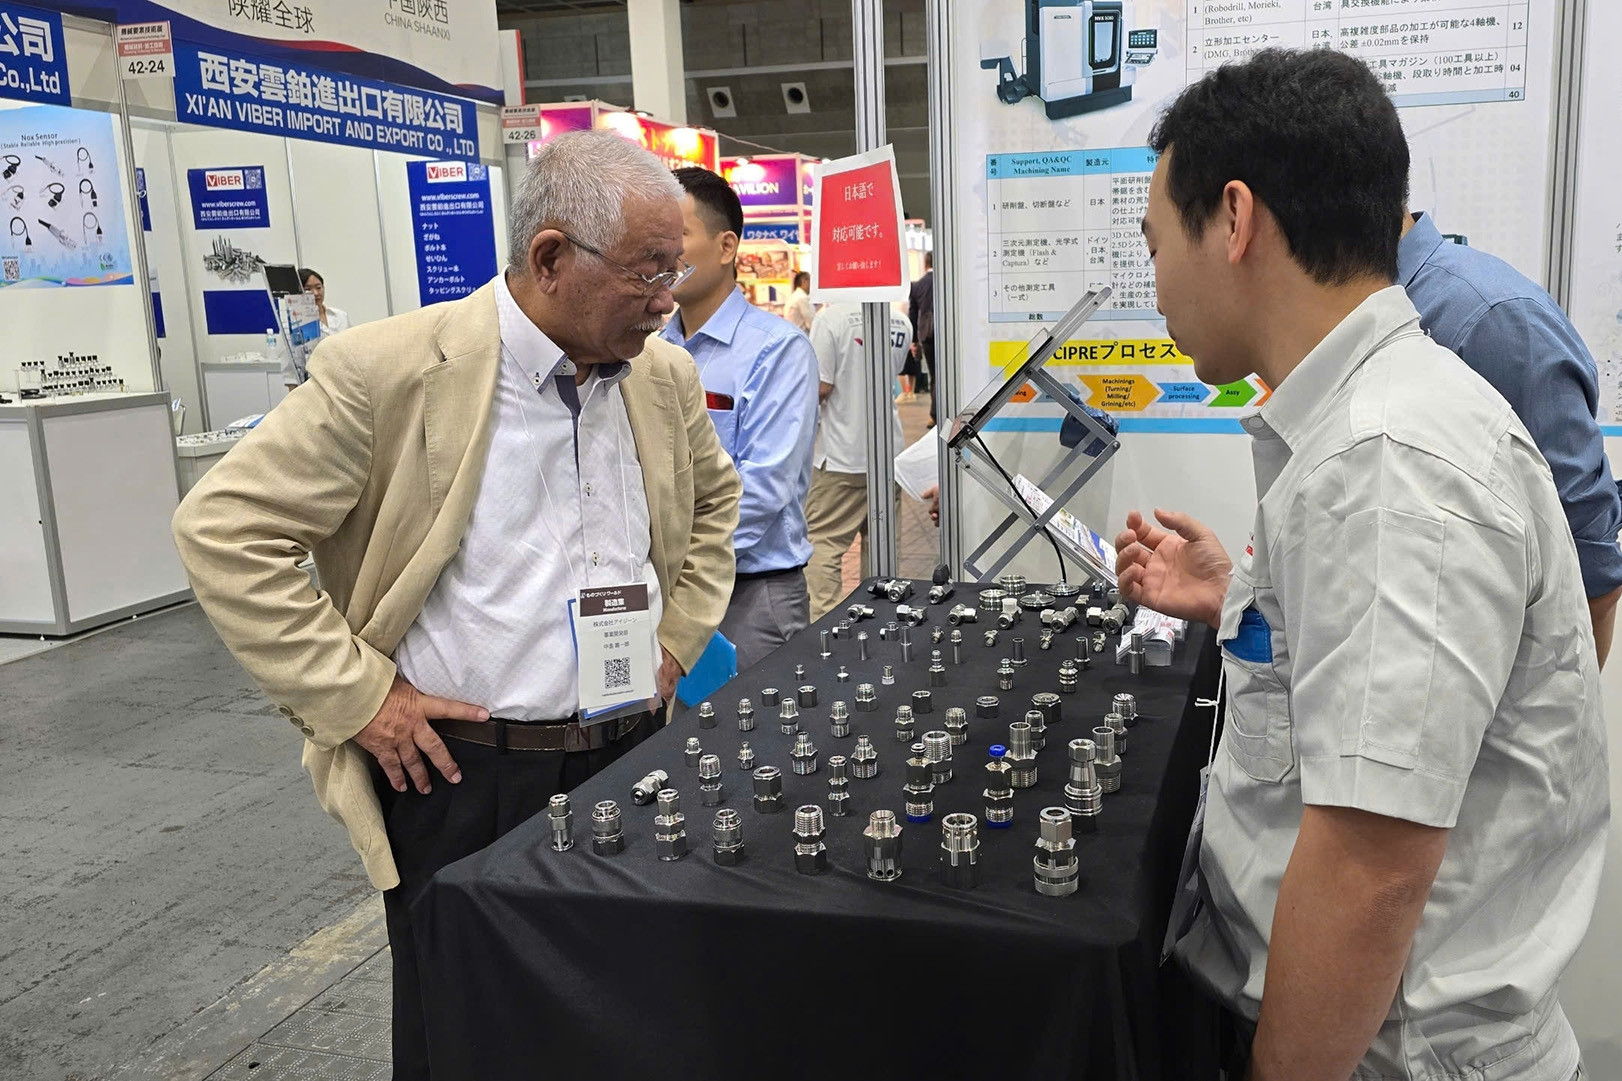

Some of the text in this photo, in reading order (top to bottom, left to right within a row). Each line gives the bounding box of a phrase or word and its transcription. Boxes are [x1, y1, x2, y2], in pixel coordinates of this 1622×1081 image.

[1193, 6, 1197, 14] 1
[1204, 1, 1246, 14] (Robodrill,
[1204, 15, 1252, 26] Brother, etc)
[384, 12, 450, 40] CHINA SHAANXI
[1512, 22, 1523, 30] 12
[1204, 33, 1279, 47] 立形加工センター
[1204, 50, 1232, 60] (DMG,
[128, 60, 165, 74] 42-24
[1510, 64, 1521, 72] 04
[197, 51, 464, 134] 西安雲鉑進出口有限公司
[1508, 91, 1520, 99] 40
[185, 93, 232, 120] XI'AN
[235, 101, 284, 127] VIBER
[286, 110, 341, 136] IMPORT
[345, 120, 374, 141] AND
[376, 125, 424, 148] EXPORT
[508, 130, 536, 140] 42-26
[1011, 155, 1072, 166] Support, QA&QC
[1085, 158, 1109, 167] 製造元
[428, 166, 464, 179] VIBER
[1013, 166, 1050, 175] Machining
[207, 174, 242, 187] VIBER
[844, 182, 874, 202] 日本語で
[1002, 199, 1071, 210] 研削盤、切断盤など
[1090, 198, 1105, 206] 日本
[422, 222, 439, 230] ナット
[747, 230, 778, 240] ワタナベ
[832, 222, 883, 243] 対応可能です。
[1123, 231, 1143, 239] CMM
[1002, 237, 1079, 247] 三次元測定機、光学式
[1087, 236, 1109, 245] ドイツ
[1003, 283, 1055, 292] その他測定工具
[1102, 378, 1135, 386] Machinings
[1168, 392, 1200, 400] processing
